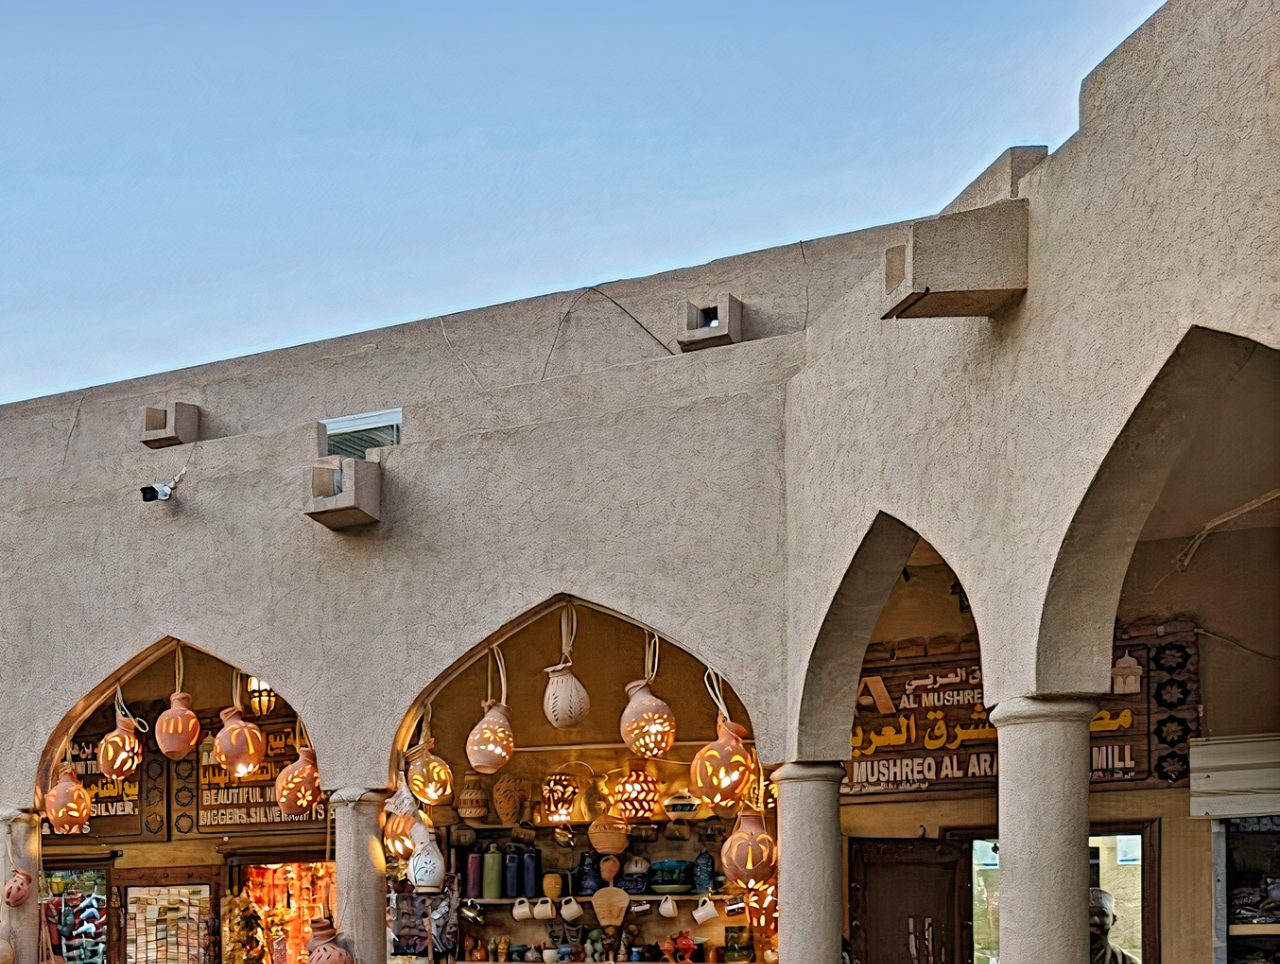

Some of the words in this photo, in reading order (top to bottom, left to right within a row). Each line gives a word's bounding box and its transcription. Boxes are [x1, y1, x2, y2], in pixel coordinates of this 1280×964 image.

[898, 694, 918, 709] AL
[921, 689, 982, 708] MUSHRE
[852, 714, 916, 758] العرب
[853, 757, 937, 782] MUSHREQ
[940, 754, 963, 778] AL
[1092, 745, 1135, 769] MILL
[202, 787, 264, 806] BEAUTIFUL
